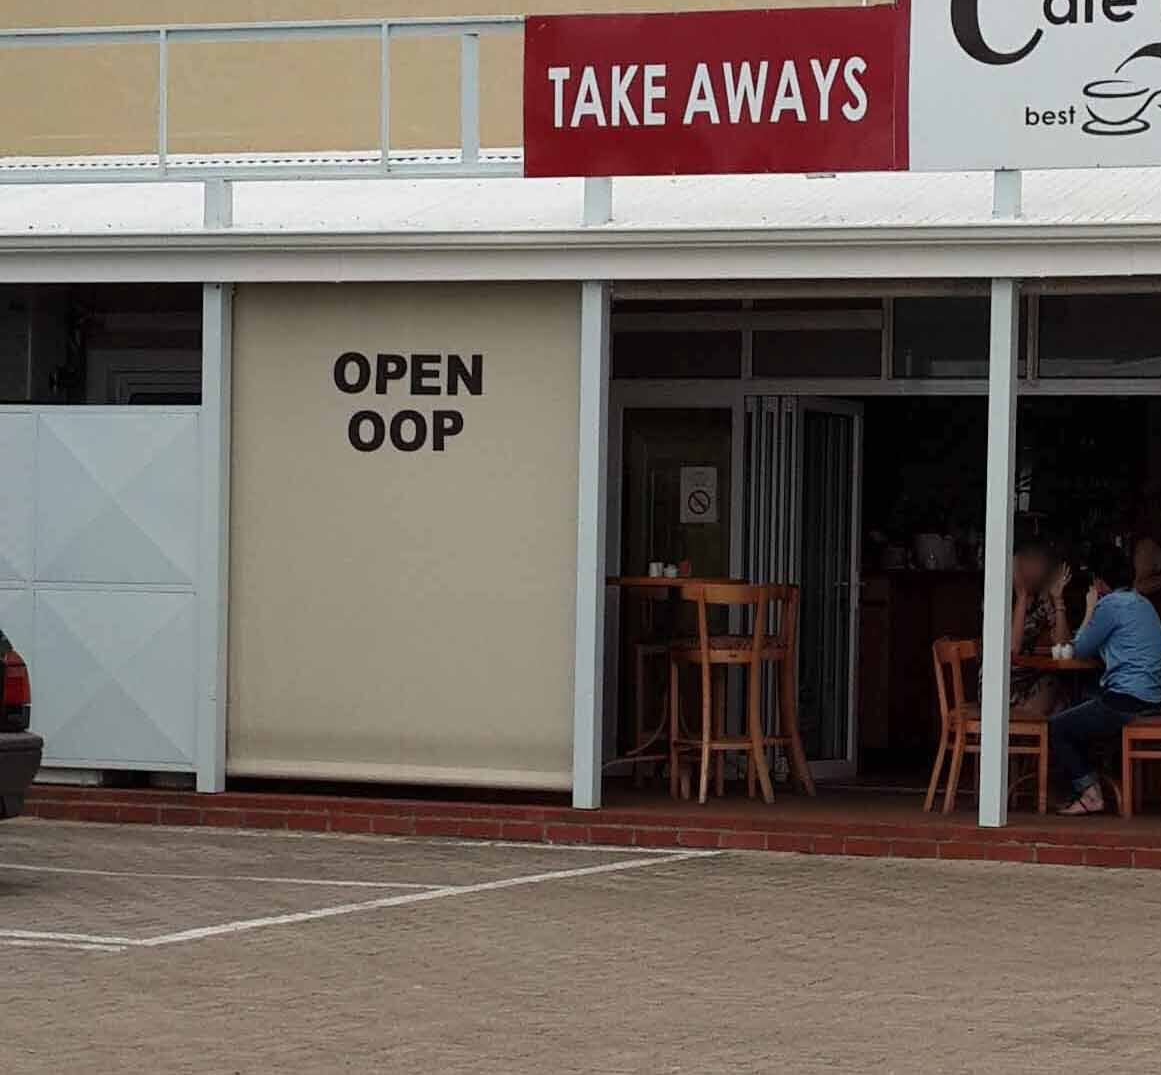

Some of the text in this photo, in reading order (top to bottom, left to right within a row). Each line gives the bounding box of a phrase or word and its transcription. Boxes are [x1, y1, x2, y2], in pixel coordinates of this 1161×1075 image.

[548, 56, 869, 128] TAKE AWAYS
[1025, 105, 1076, 126] best
[334, 352, 483, 395] OPEN
[348, 410, 464, 452] OOP
